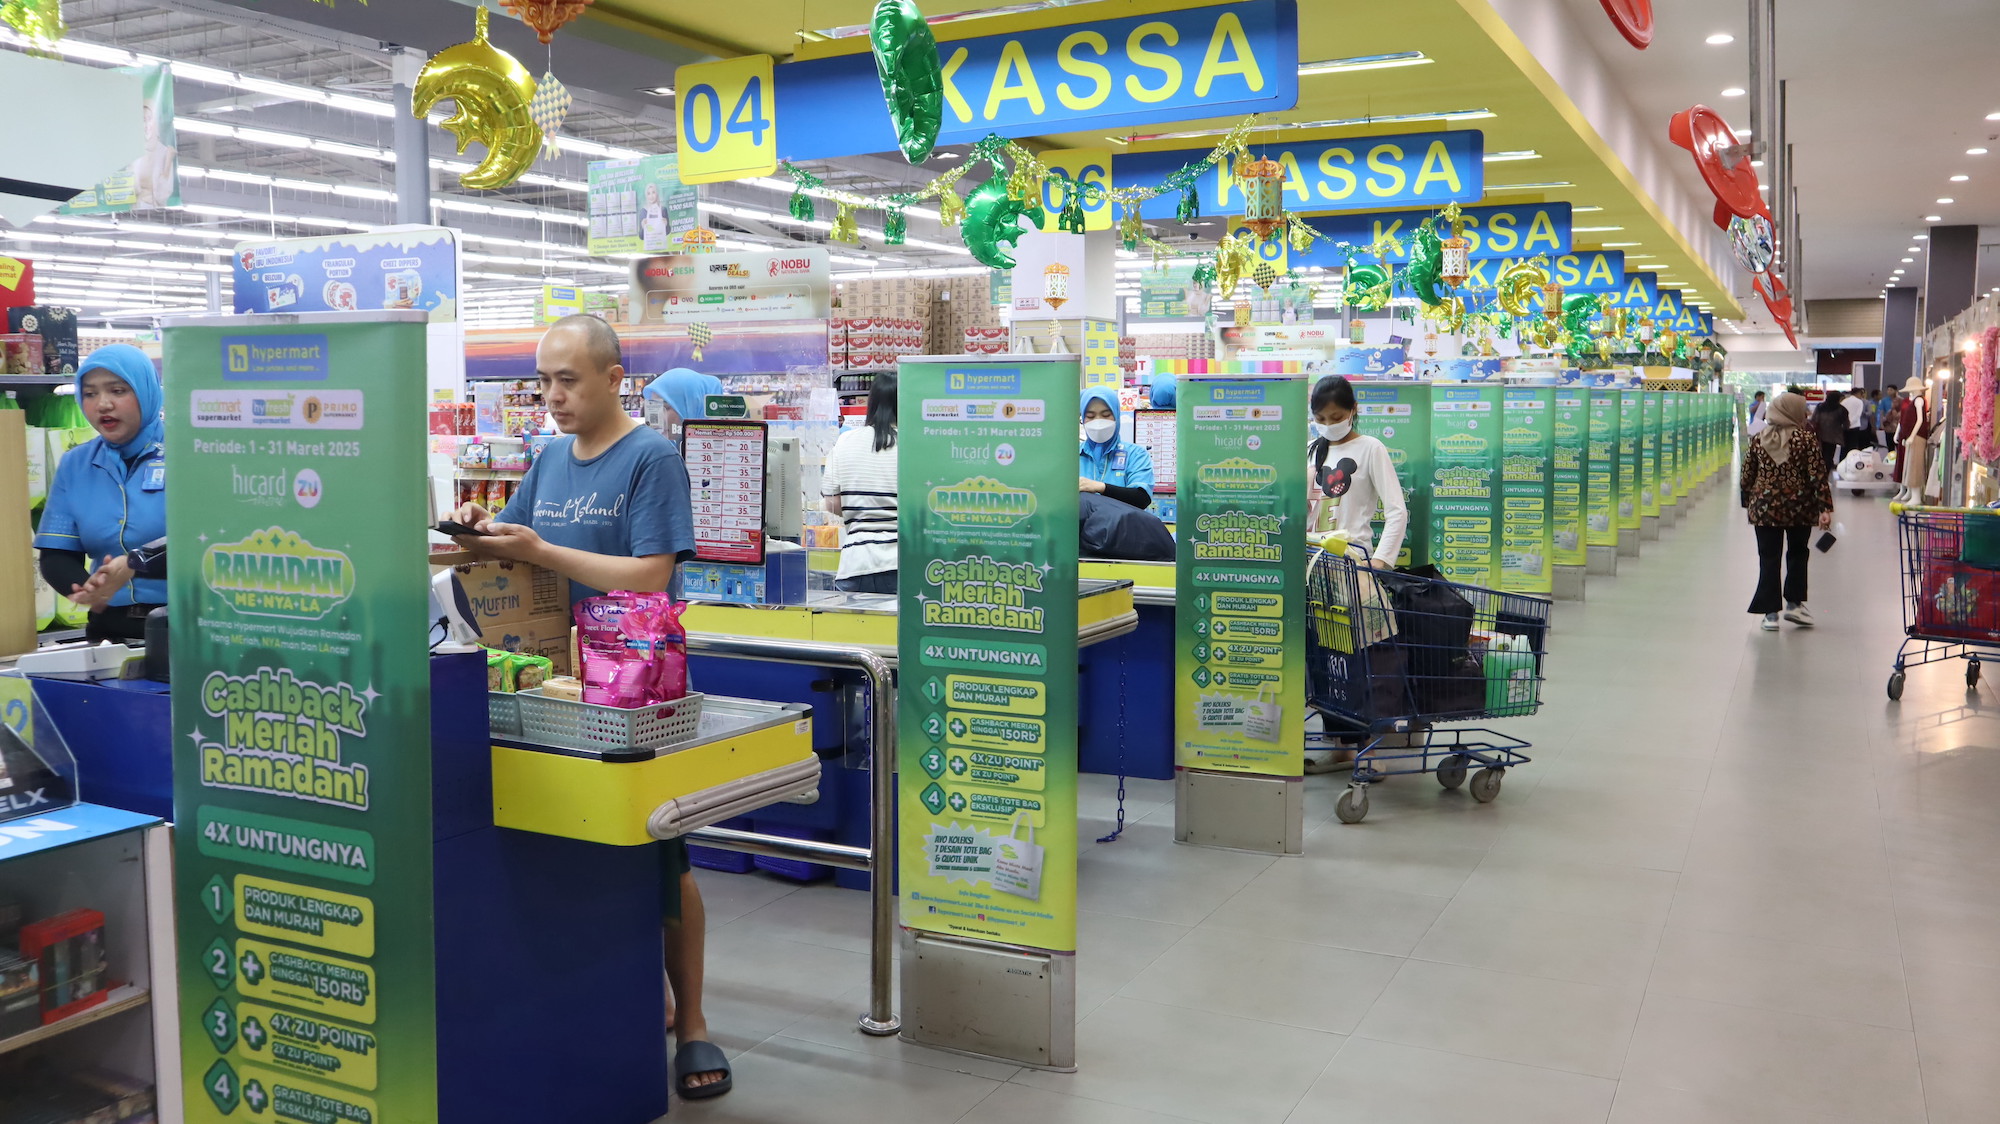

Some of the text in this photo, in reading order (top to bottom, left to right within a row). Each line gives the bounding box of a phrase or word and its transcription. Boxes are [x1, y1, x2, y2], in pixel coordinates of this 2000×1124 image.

[683, 12, 1265, 153] 04 KASSA
[1041, 164, 1107, 214] 06
[255, 247, 276, 256] FAVORIT
[265, 255, 293, 266] INDONESIA
[398, 258, 419, 267] DIPPERS
[781, 259, 811, 269] NOBU
[329, 269, 349, 277] PORTION
[252, 345, 320, 362] hypermart
[967, 374, 1015, 384] hypermart
[197, 399, 241, 413] foodmart
[323, 403, 357, 412] PRIMO
[197, 414, 241, 422] supermarket
[923, 427, 1042, 437] Periode: 31 Maret 2025
[1215, 434, 1243, 446] hicard
[194, 439, 360, 456] Periode: 1 31 Maret 2025
[951, 441, 989, 460] hicard
[1203, 467, 1272, 483] RAMADAN
[1435, 467, 1490, 481] Cashback
[1504, 465, 1536, 473] Meriah
[231, 464, 287, 496] hicard
[1443, 479, 1481, 487] Meriah
[1435, 487, 1490, 497] Ramadan!
[570, 492, 624, 522] Island
[934, 490, 1029, 515] RAMADAN
[1197, 512, 1281, 534] Cashback
[1210, 528, 1266, 545] Meriah
[1196, 544, 1281, 560] Ramadan!
[212, 550, 345, 598] RAMADAN
[927, 558, 1042, 590] Cashback
[1196, 573, 1280, 584] 4X UNTUNGNYA
[943, 581, 1023, 608] Meriah
[1200, 597, 1205, 607] 1
[472, 595, 520, 617] MUFFIN
[925, 602, 1042, 631] Ramadan!
[197, 617, 362, 641] Bersama Hypermart Wujudkan Ramadan
[601, 624, 619, 632] Floral
[1198, 623, 1206, 633] 2
[210, 633, 230, 645] Yang
[301, 641, 318, 651] Dan
[925, 645, 1042, 667] 4X UNTUNGNYA
[1198, 647, 1206, 657] 3
[1197, 671, 1206, 682] 4
[929, 682, 1036, 697] 1 PRODUK LENGKAP
[953, 692, 1008, 703] DAN MURAH
[203, 668, 365, 735] Cashback
[928, 719, 1039, 734] 2 CASHBACK MERIAH
[971, 726, 999, 734] HINGGA
[227, 711, 338, 763] Meriah
[928, 754, 1002, 770] 3 4X ZU
[202, 747, 366, 807] Ramadan!
[928, 791, 938, 805] 4
[971, 794, 999, 803] GRATIS
[1000, 798, 1021, 806] TOTE
[204, 821, 367, 868] 4X UNTUNGNYA
[948, 836, 974, 844] KOLEKSI
[939, 845, 962, 854] DESAIN
[963, 846, 978, 855] TOTE
[979, 847, 992, 855] BAG
[941, 855, 979, 864] QUOTE UNIK
[211, 885, 360, 921] 1 PRODUK LENGKAP
[245, 905, 320, 932] DAN MURAH
[212, 949, 365, 983] 2 CASHBACK MERIAH
[271, 967, 310, 983] HINGGA
[214, 1011, 227, 1037] 3
[271, 1014, 291, 1031] 4X
[295, 1020, 315, 1037] ZU
[273, 1043, 285, 1055] 2X
[288, 1047, 301, 1059] ZU
[214, 1074, 369, 1120] 4 GRATIS TOTE BAG
